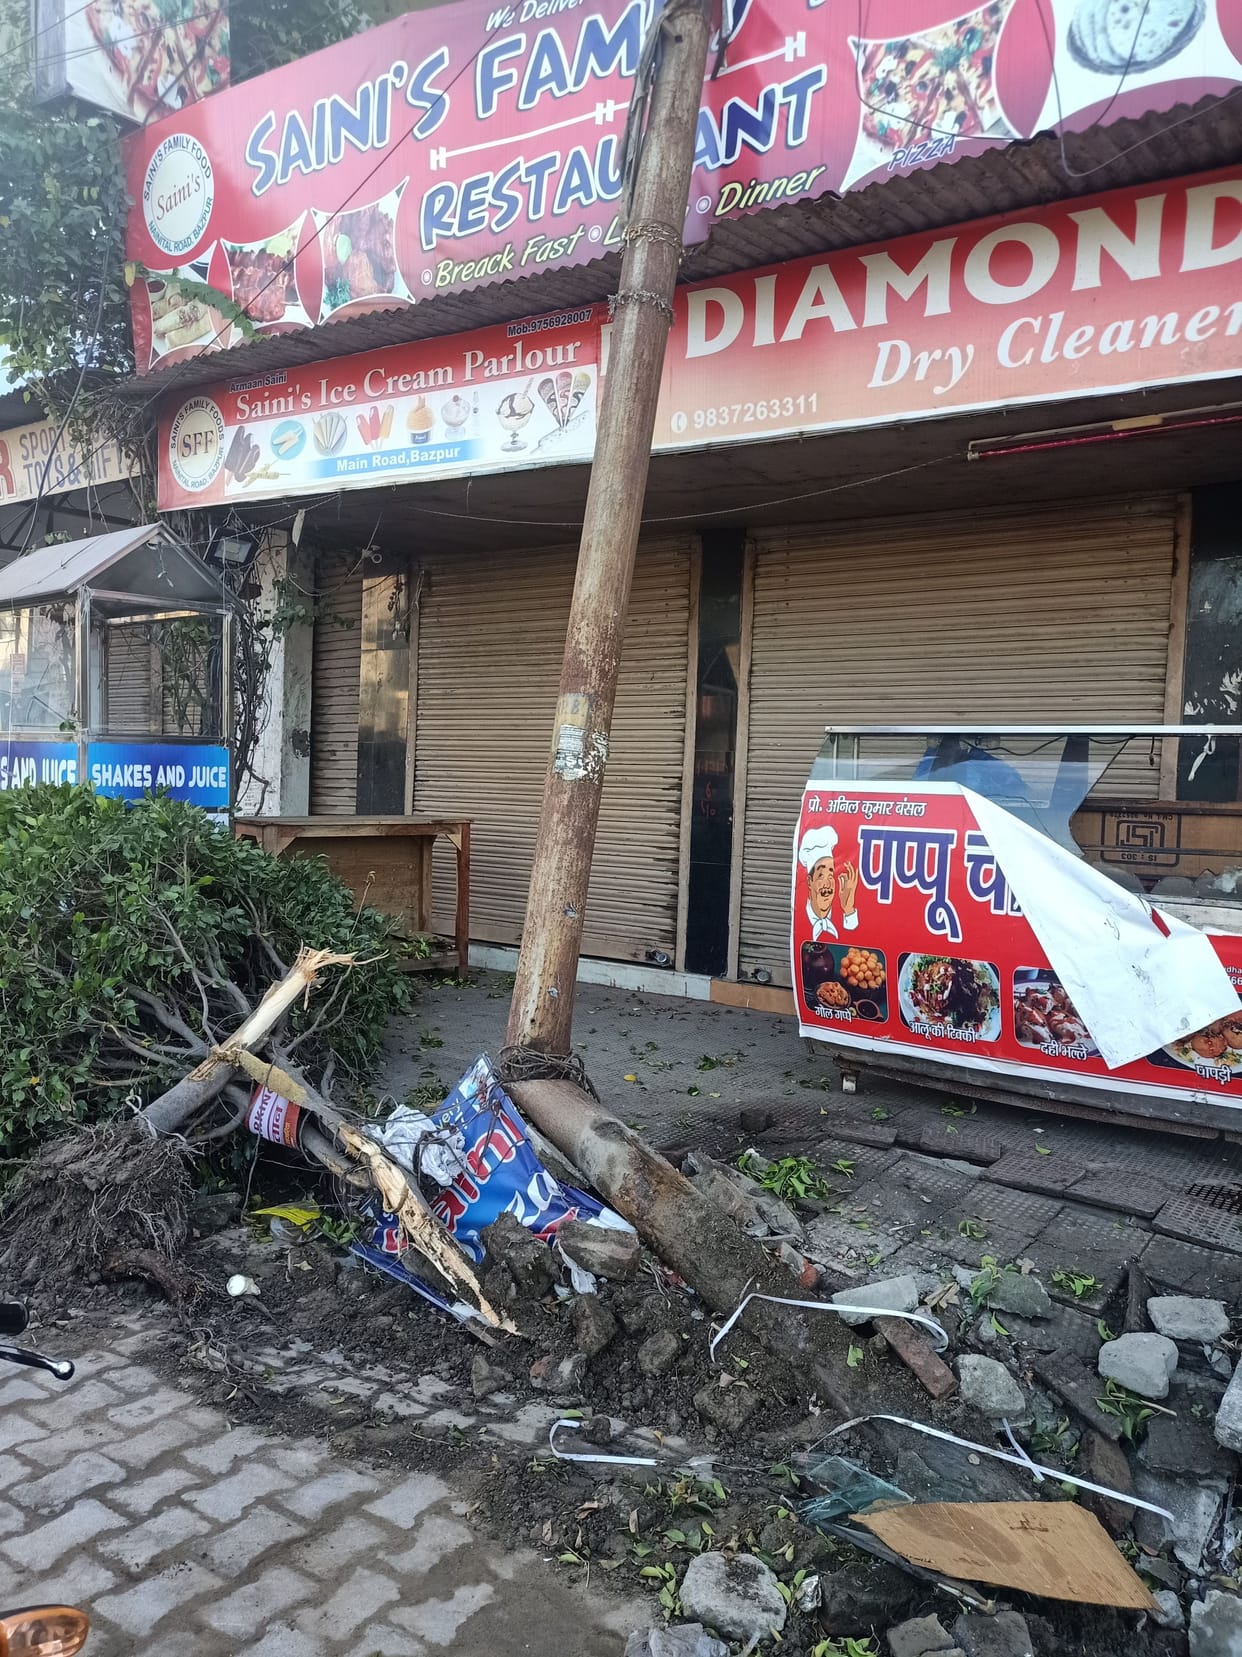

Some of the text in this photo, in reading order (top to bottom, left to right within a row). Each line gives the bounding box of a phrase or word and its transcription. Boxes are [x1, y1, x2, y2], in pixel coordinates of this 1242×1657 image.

[245, 46, 450, 197] SAINI'S
[143, 135, 212, 201] SAINI'S FAMILY FOOD
[418, 63, 828, 252] RESTAUANT
[887, 135, 955, 171] PIZZA
[156, 173, 201, 221] Saini's
[435, 165, 827, 288] Breack Fast Dinner
[685, 180, 1242, 360] DIAMOND
[230, 370, 288, 393] Armaan Saini
[236, 384, 312, 421] Saini's
[318, 378, 357, 406] Ice
[363, 363, 454, 398] Cream
[462, 340, 582, 382] Parlour
[867, 338, 975, 395] Dry
[184, 399, 211, 414] FAMILY
[209, 405, 225, 441] FOODS
[693, 394, 819, 430] 9837263311
[20, 424, 72, 461] SPORT
[181, 430, 214, 458] SFF
[336, 455, 368, 472] Main
[92, 763, 227, 789] SHAKES AND JUICE
[826, 795, 861, 814] अनिल
[861, 800, 895, 820] कुमार
[895, 796, 927, 817] बंसल
